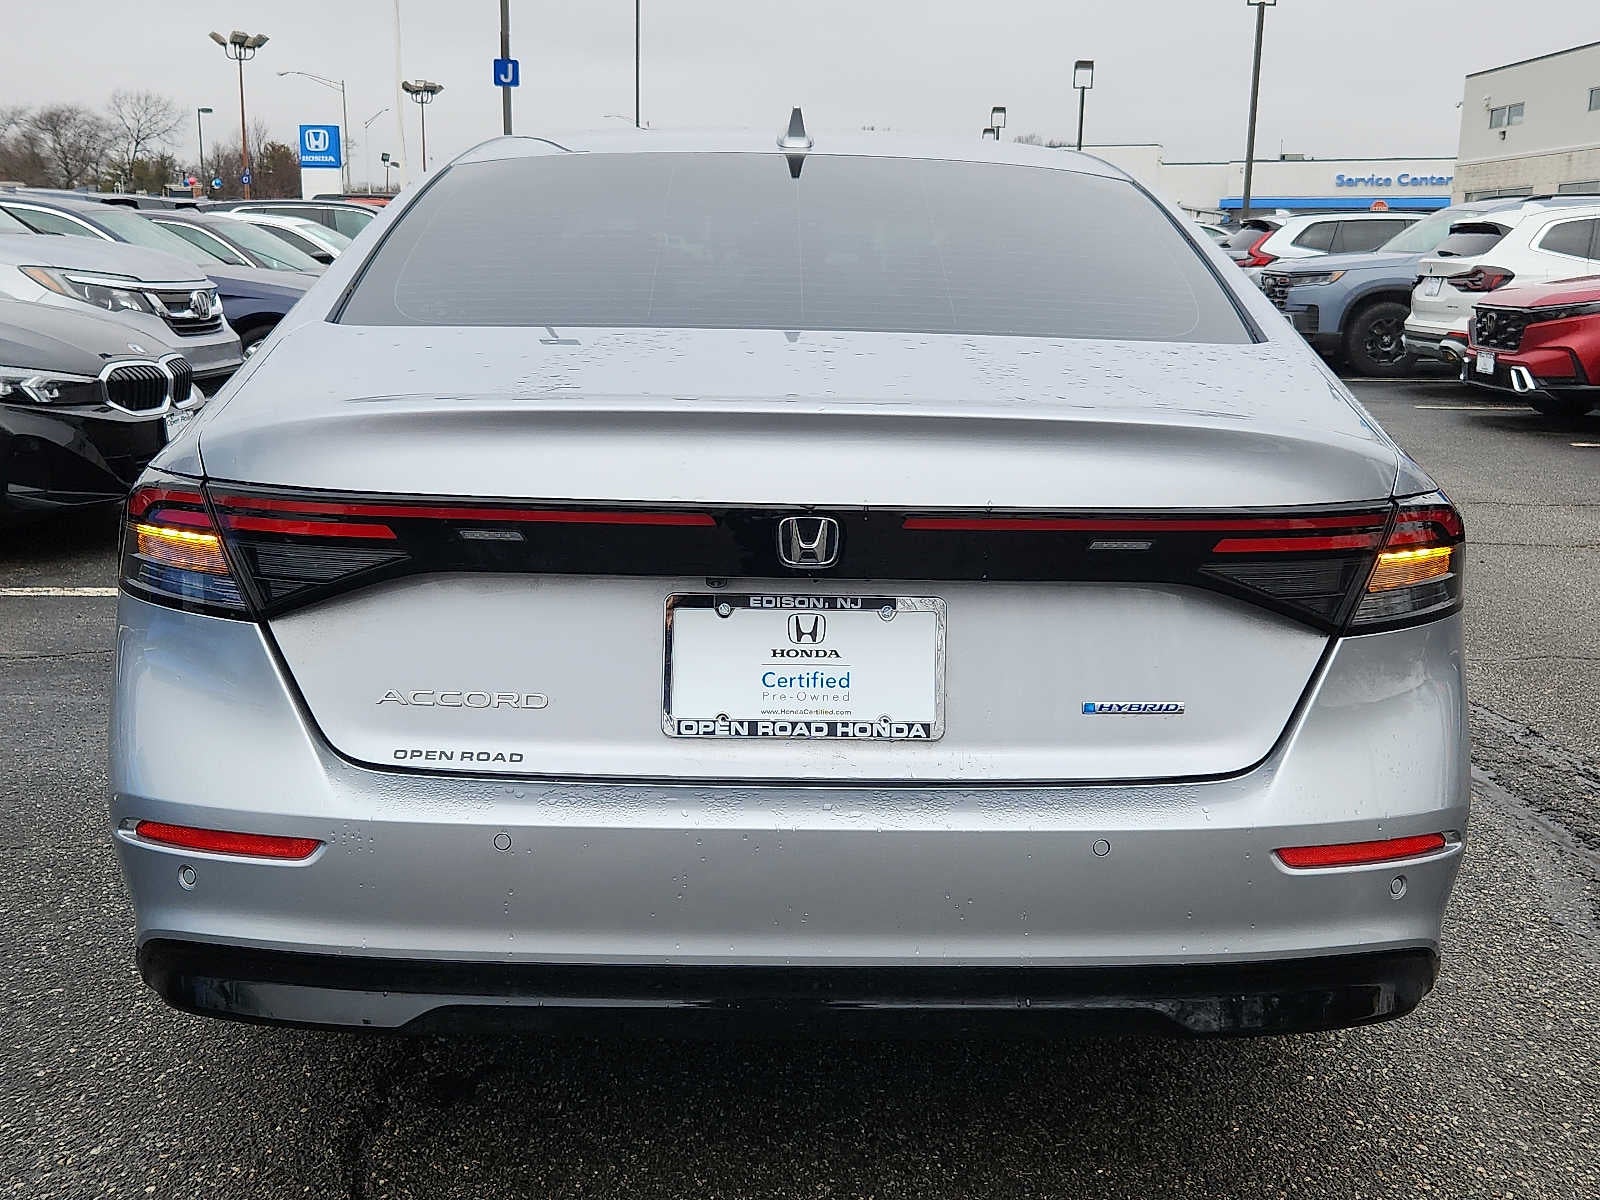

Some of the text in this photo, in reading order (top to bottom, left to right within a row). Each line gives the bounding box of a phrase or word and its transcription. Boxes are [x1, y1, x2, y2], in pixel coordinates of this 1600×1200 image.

[500, 63, 514, 83] J
[1335, 173, 1453, 187] Service Center
[836, 597, 862, 609] NJ
[771, 648, 842, 659] HONDA
[761, 671, 850, 689] Certified
[375, 687, 549, 710] ACCORD
[762, 691, 850, 702] Pre-Owned
[1098, 703, 1179, 712] HYBRID
[679, 720, 927, 738] OPEN ROAD HONDA
[393, 749, 524, 763] OPEN ROAD
